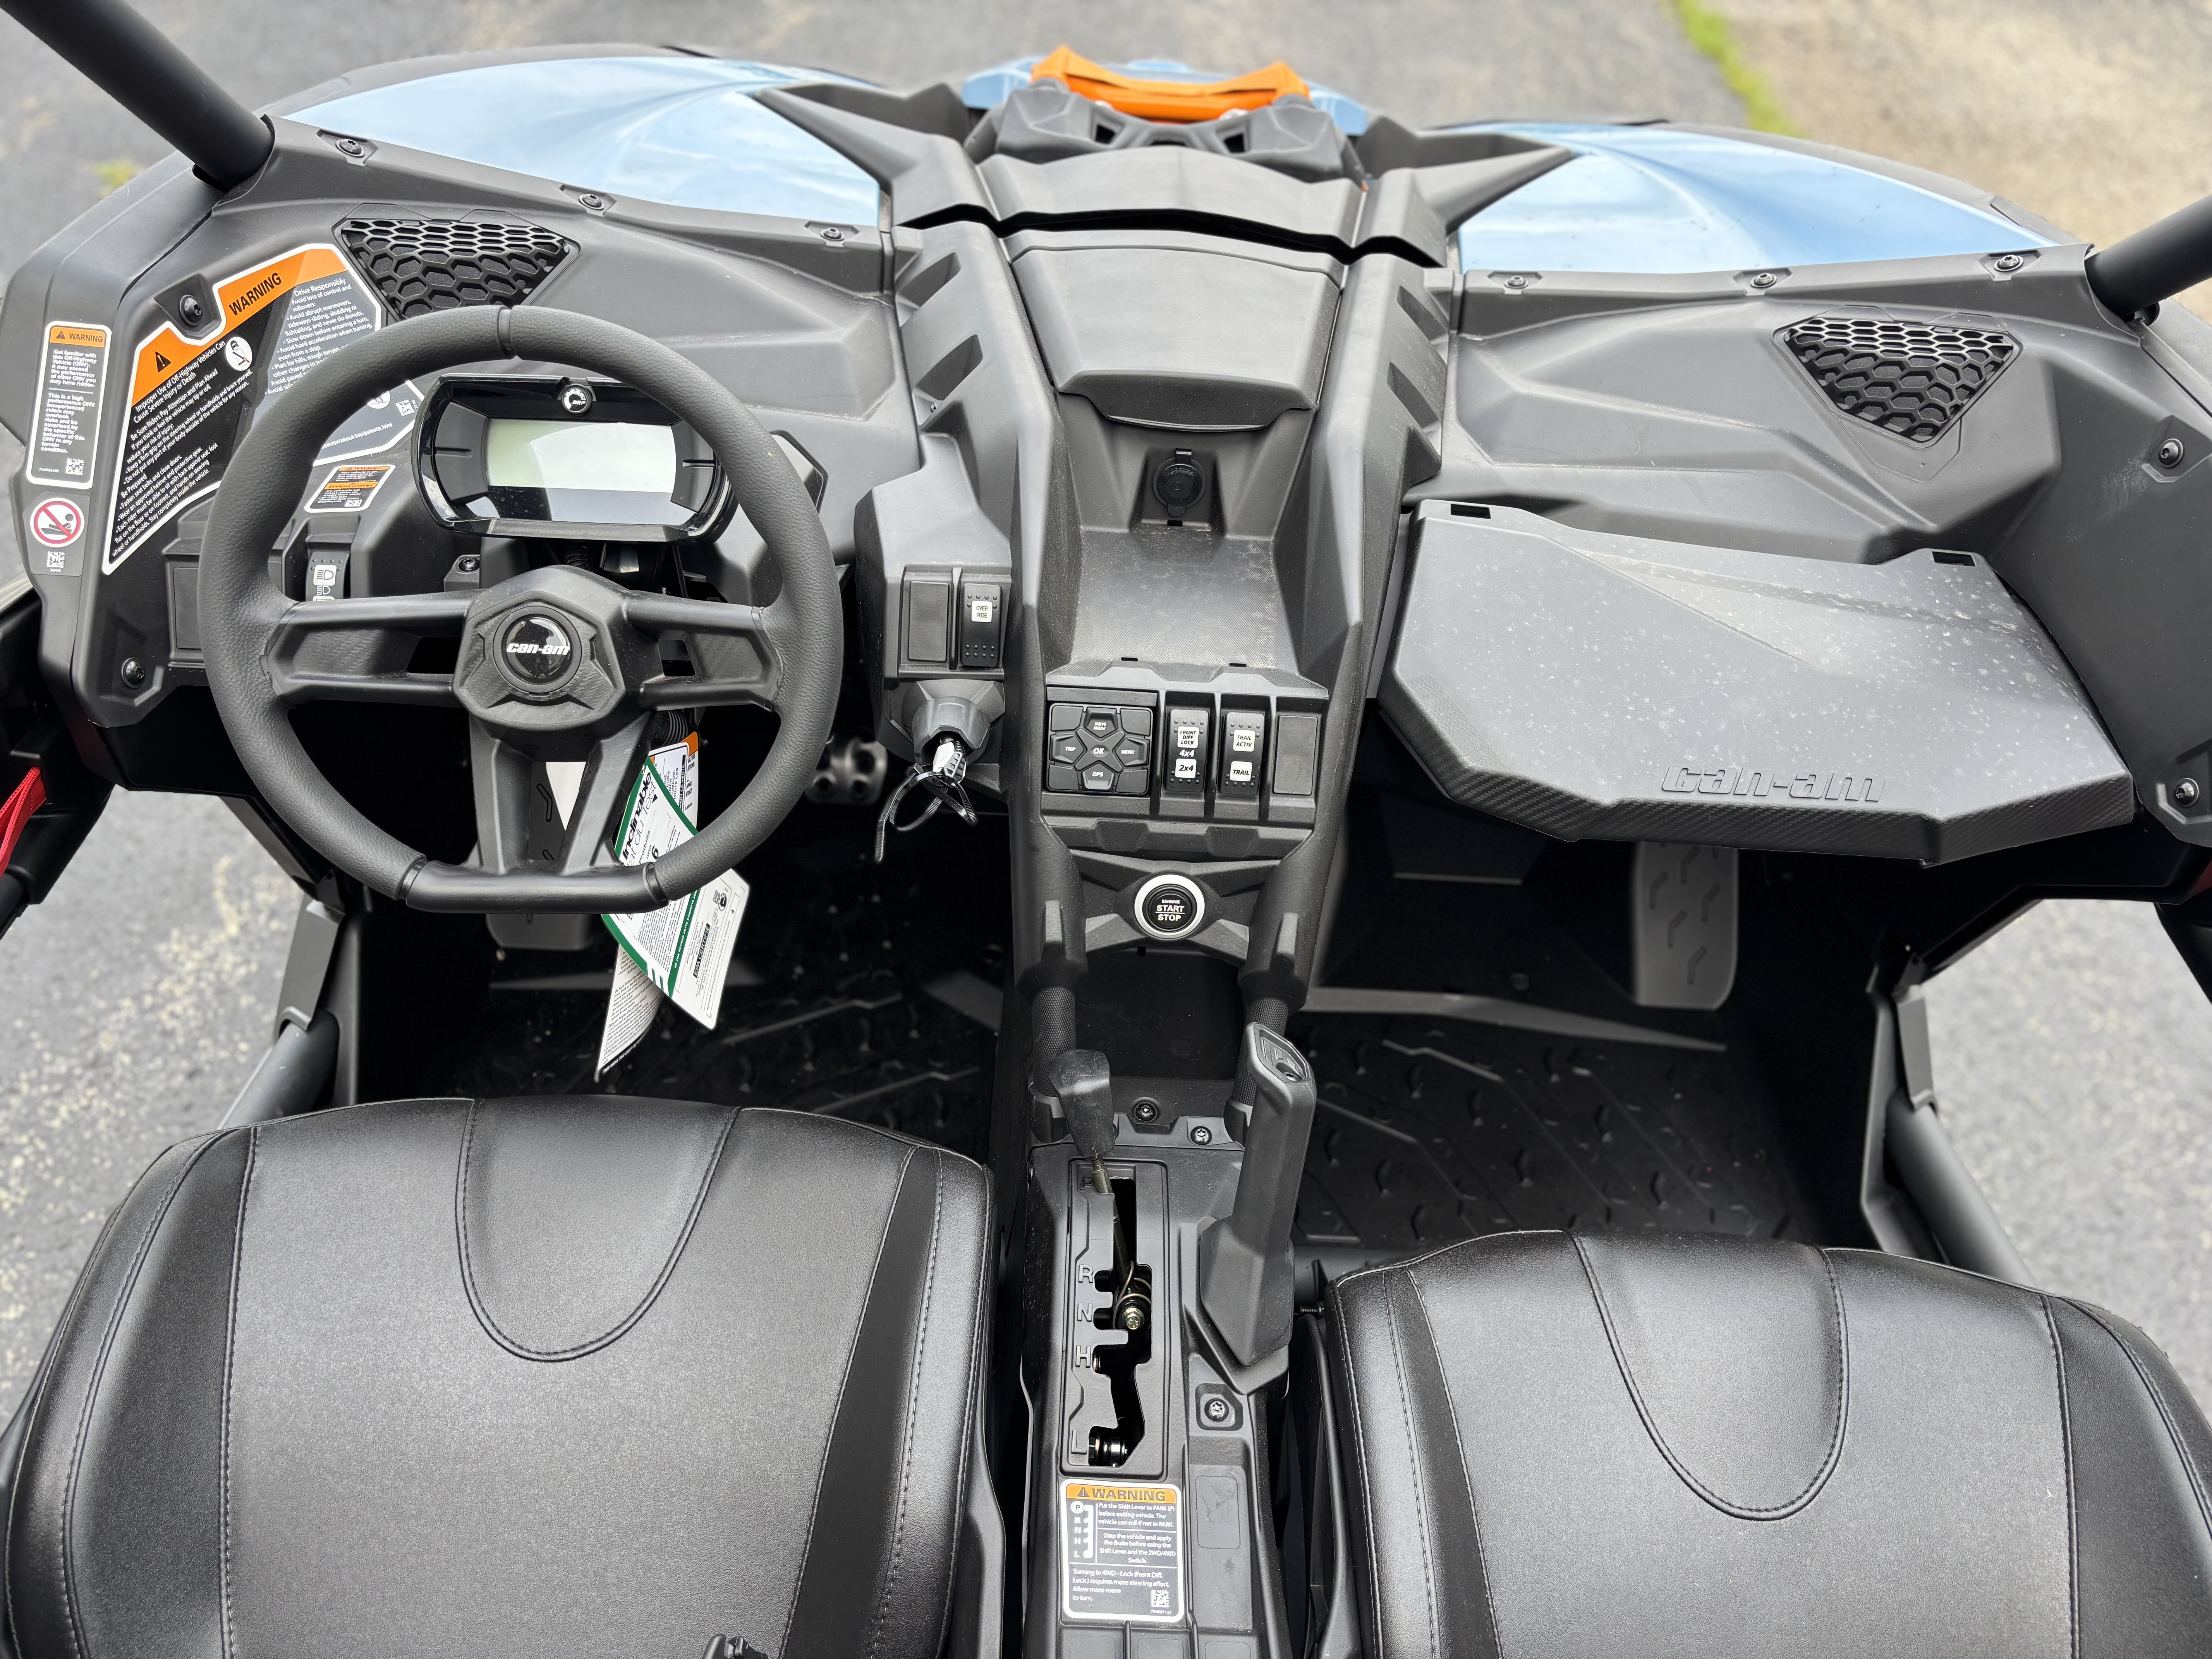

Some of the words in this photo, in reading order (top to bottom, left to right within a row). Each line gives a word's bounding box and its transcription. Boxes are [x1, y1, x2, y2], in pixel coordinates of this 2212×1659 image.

[228, 272, 282, 316] WARNING
[310, 278, 346, 292] Responsibly
[291, 296, 307, 305] Avoid
[323, 287, 341, 296] control
[287, 318, 311, 328] sideways
[330, 307, 352, 316] skidding
[289, 311, 305, 320] Avoid
[305, 307, 323, 316] abrupt
[69, 333, 103, 342] WARNING
[314, 328, 331, 336] before
[331, 321, 353, 331] entering
[135, 392, 158, 412] Improper
[156, 386, 167, 395] Use
[166, 380, 172, 388] of
[171, 361, 199, 384] Off-Highway
[197, 347, 216, 363] Vehicles
[215, 341, 225, 350] Can
[134, 410, 149, 423] Cause
[148, 397, 164, 412] Severe
[163, 387, 177, 400] Injury
[181, 372, 196, 385] Death
[136, 426, 148, 436] Sure
[146, 414, 161, 428] Riders
[159, 408, 168, 417] Pay
[168, 393, 188, 411] Attention
[187, 385, 196, 395] and
[194, 380, 205, 389] Plan
[204, 368, 218, 382] Ahead
[507, 643, 569, 655] can-am
[1662, 765, 1886, 802] can-am
[623, 772, 651, 860] Inclinable
[1078, 1264, 1094, 1283] R
[1077, 1303, 1092, 1322] N
[1075, 1345, 1091, 1368] H
[1071, 1430, 1087, 1455] L
[1092, 1488, 1165, 1501] WARNING
